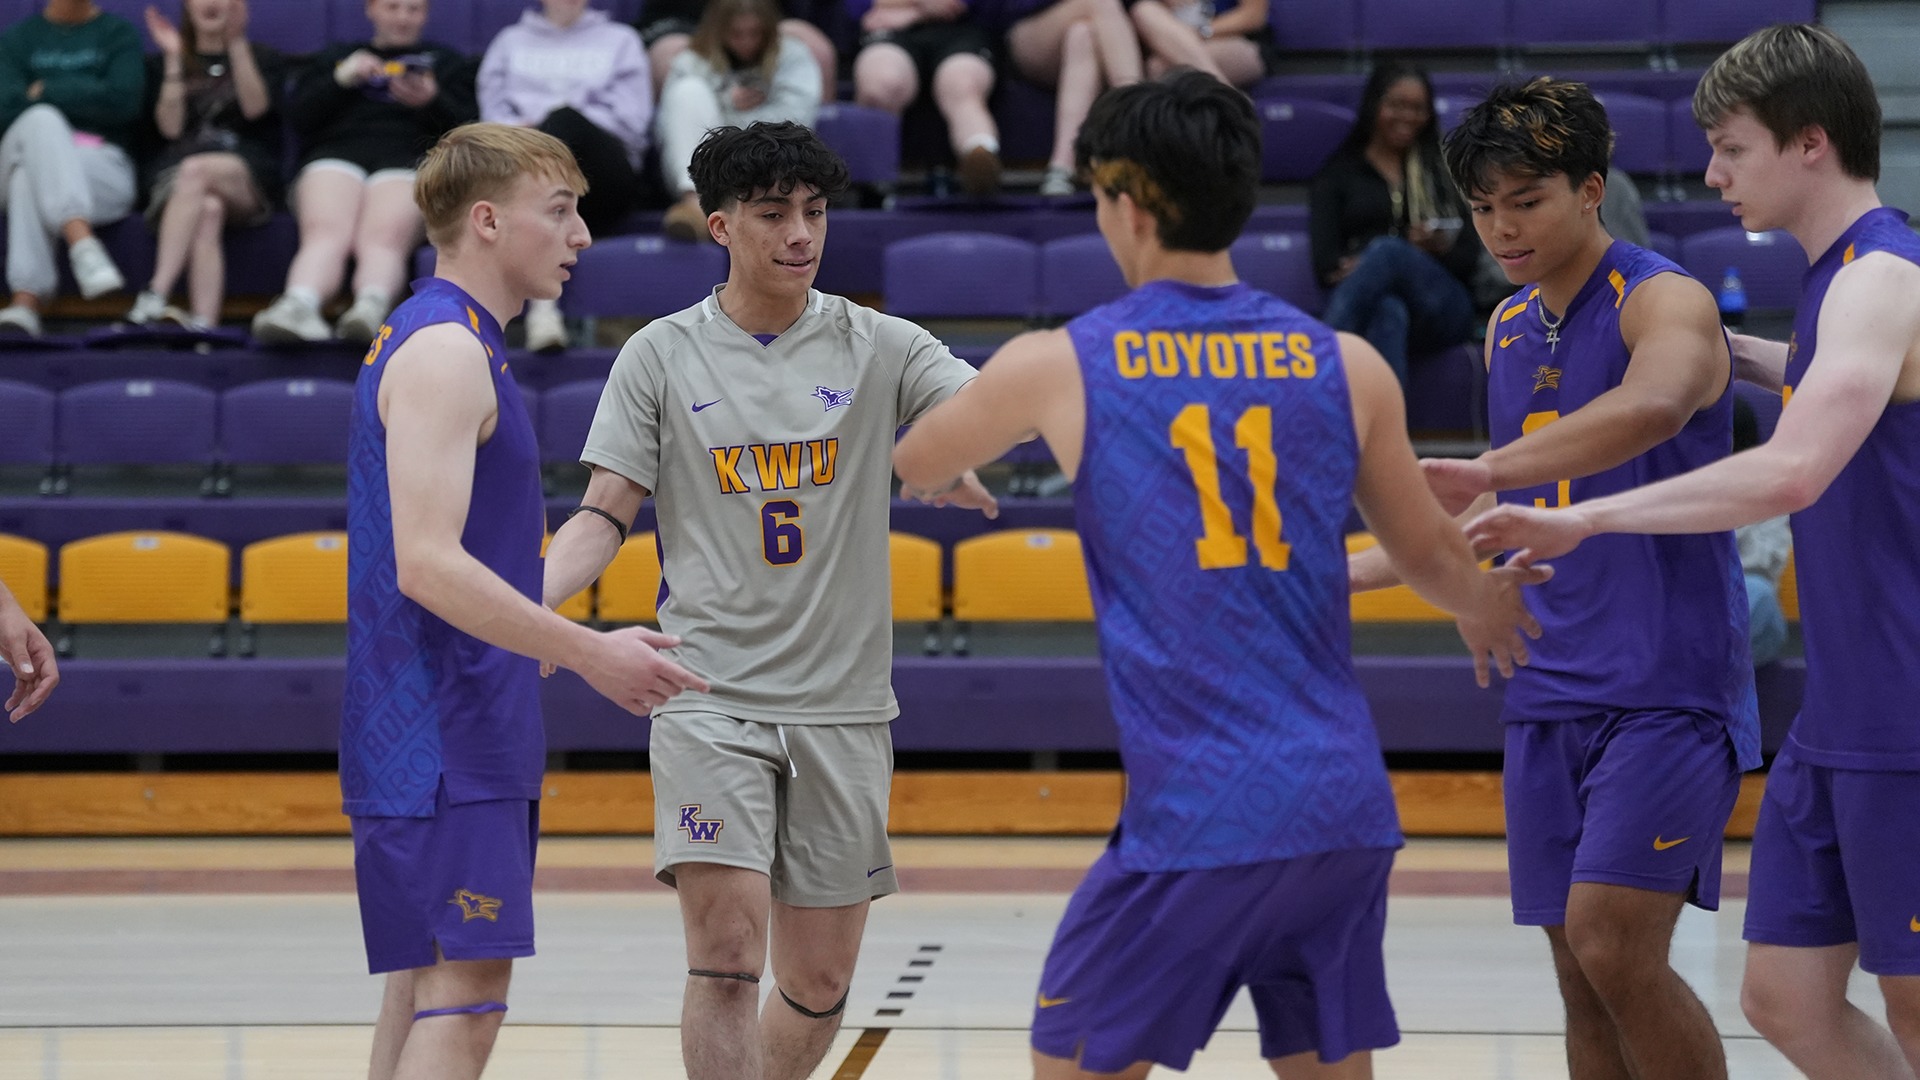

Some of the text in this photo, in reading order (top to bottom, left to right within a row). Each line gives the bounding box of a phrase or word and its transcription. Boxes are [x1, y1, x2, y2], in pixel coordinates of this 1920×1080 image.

[1113, 330, 1318, 379] COYOTES
[709, 437, 839, 494] KWU
[1169, 403, 1291, 571] 11
[759, 498, 804, 567] 6
[678, 804, 724, 844] KW
